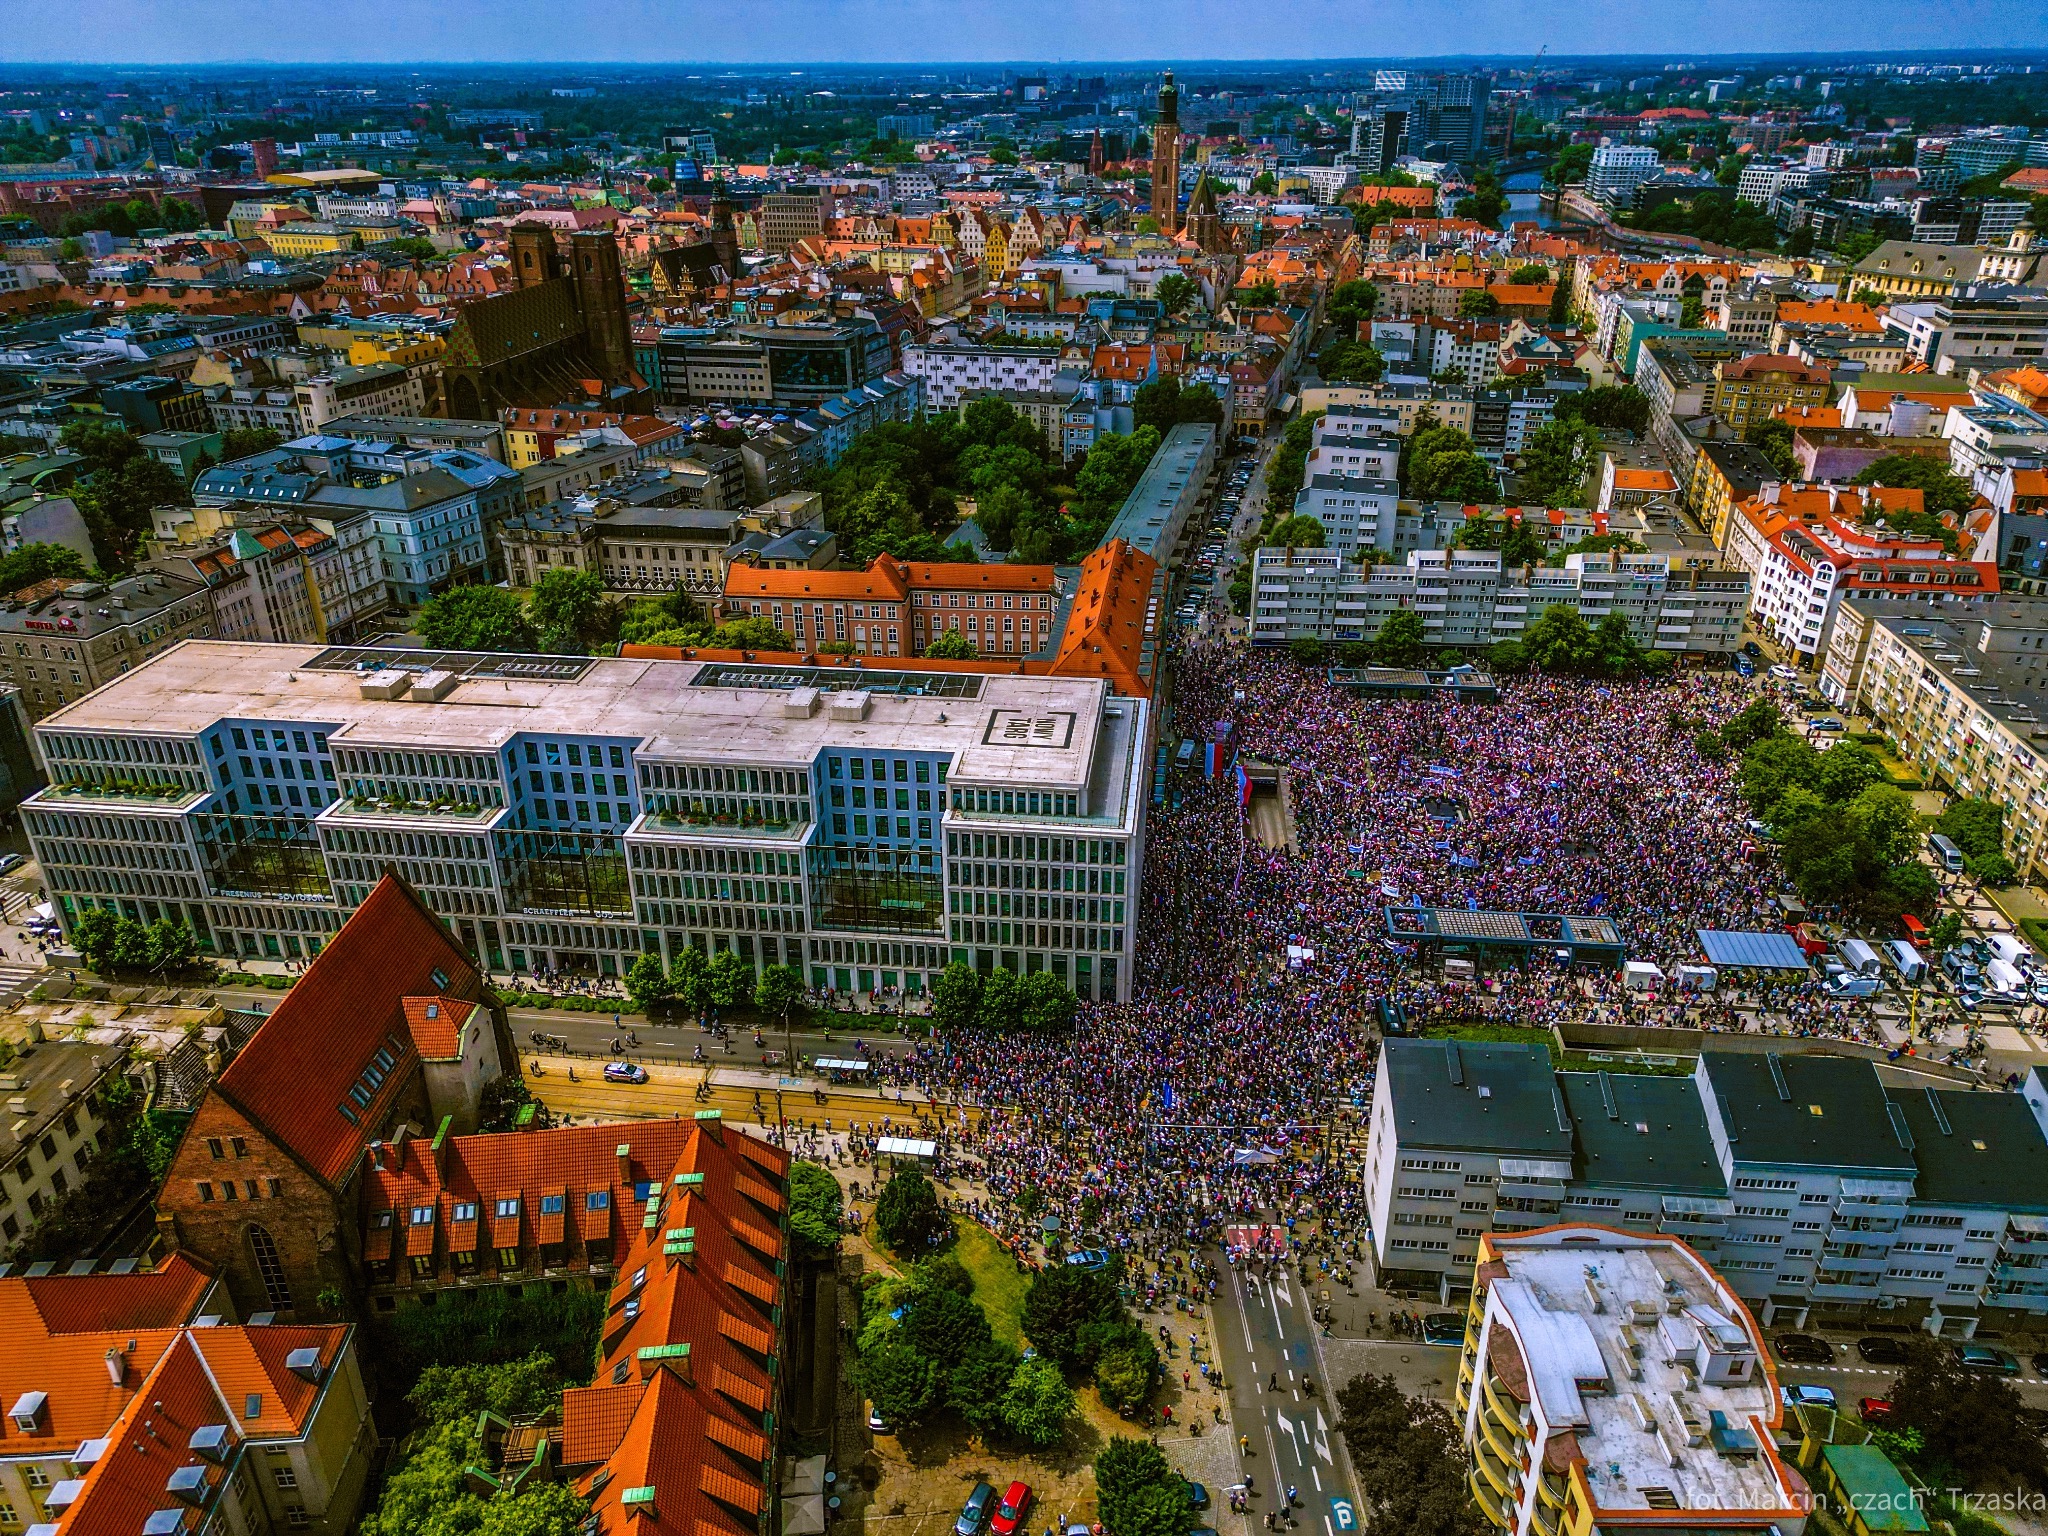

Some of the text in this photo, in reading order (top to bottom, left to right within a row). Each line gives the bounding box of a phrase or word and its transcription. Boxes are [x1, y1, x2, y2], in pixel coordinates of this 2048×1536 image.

[1003, 717, 1031, 739] TARG
[1032, 718, 1056, 740] NOWY
[220, 889, 262, 898] FRESENIUS
[278, 893, 325, 902] spyrosoft
[523, 907, 575, 917] SCHAEFFLER
[1337, 1509, 1351, 1528] P
